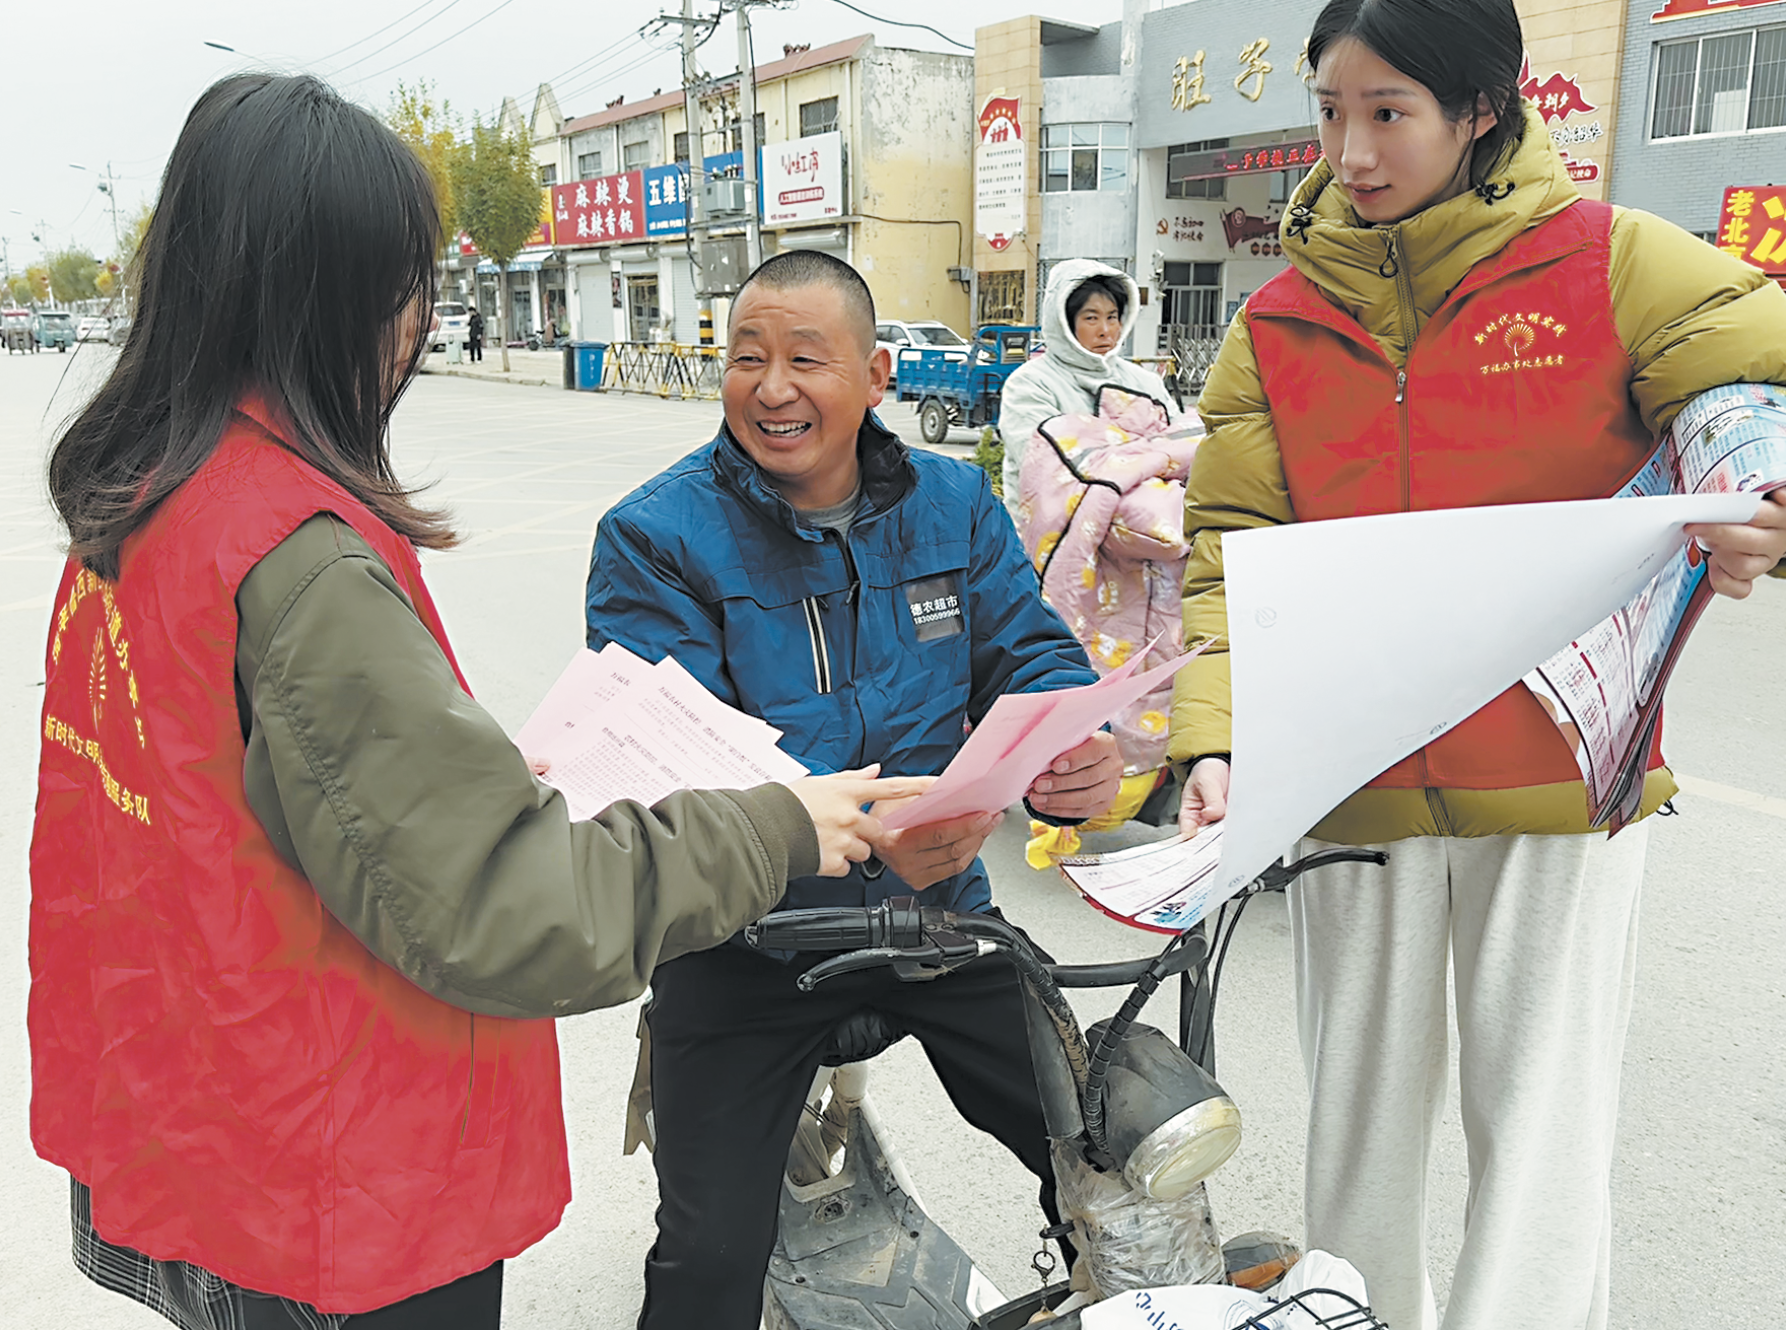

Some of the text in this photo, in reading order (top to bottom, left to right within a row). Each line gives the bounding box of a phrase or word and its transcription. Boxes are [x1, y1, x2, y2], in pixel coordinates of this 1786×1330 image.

[575, 175, 633, 208] 麻辣烫
[576, 208, 633, 238] 麻辣香锅
[910, 595, 958, 616] 德农超市
